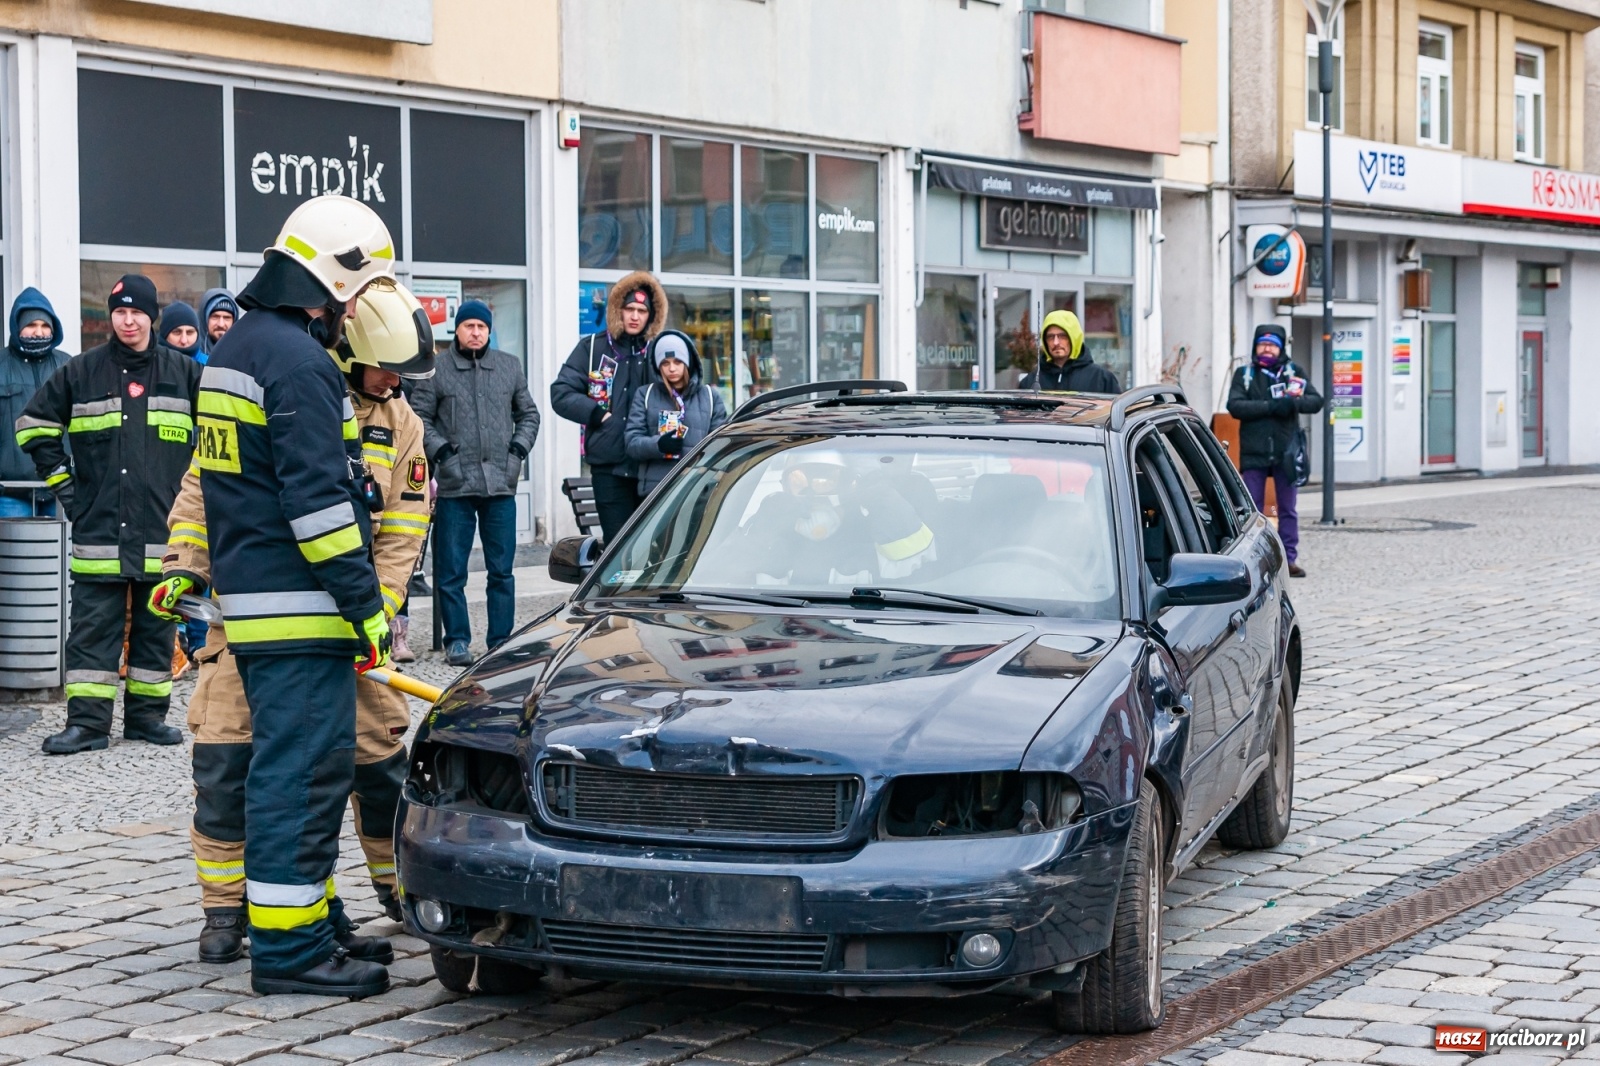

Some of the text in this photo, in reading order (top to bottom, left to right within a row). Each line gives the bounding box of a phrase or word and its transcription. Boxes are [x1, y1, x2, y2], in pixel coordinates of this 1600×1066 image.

[251, 135, 386, 203] empik
[1381, 153, 1406, 177] TEB
[818, 206, 875, 235] empik.com
[1000, 201, 1086, 246] gelatopiu
